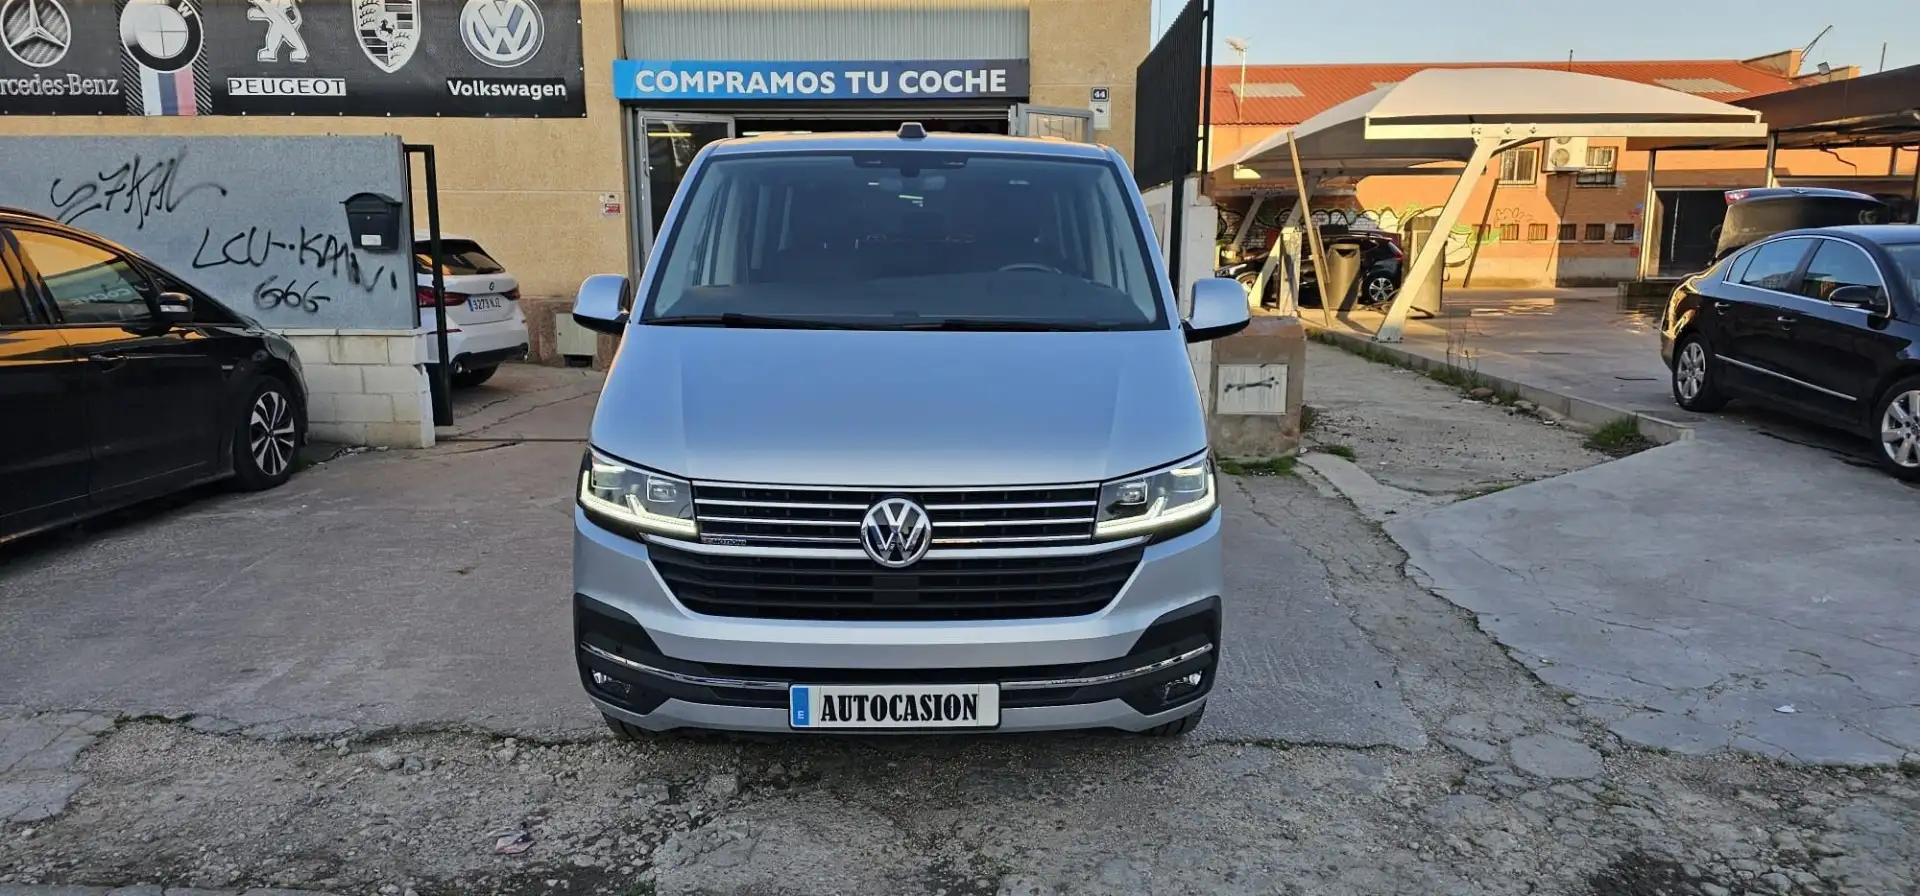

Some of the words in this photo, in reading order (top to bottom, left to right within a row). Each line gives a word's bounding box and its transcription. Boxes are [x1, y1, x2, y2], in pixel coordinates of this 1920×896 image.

[0, 73, 119, 96] rcedes-Benz
[229, 79, 345, 94] PEUGEOT
[447, 80, 567, 100] Volkswagen
[635, 70, 836, 94] COMPRAMOS
[845, 71, 889, 94] TU
[899, 69, 1007, 94] COCHE
[820, 693, 979, 722] AUTOCASION
